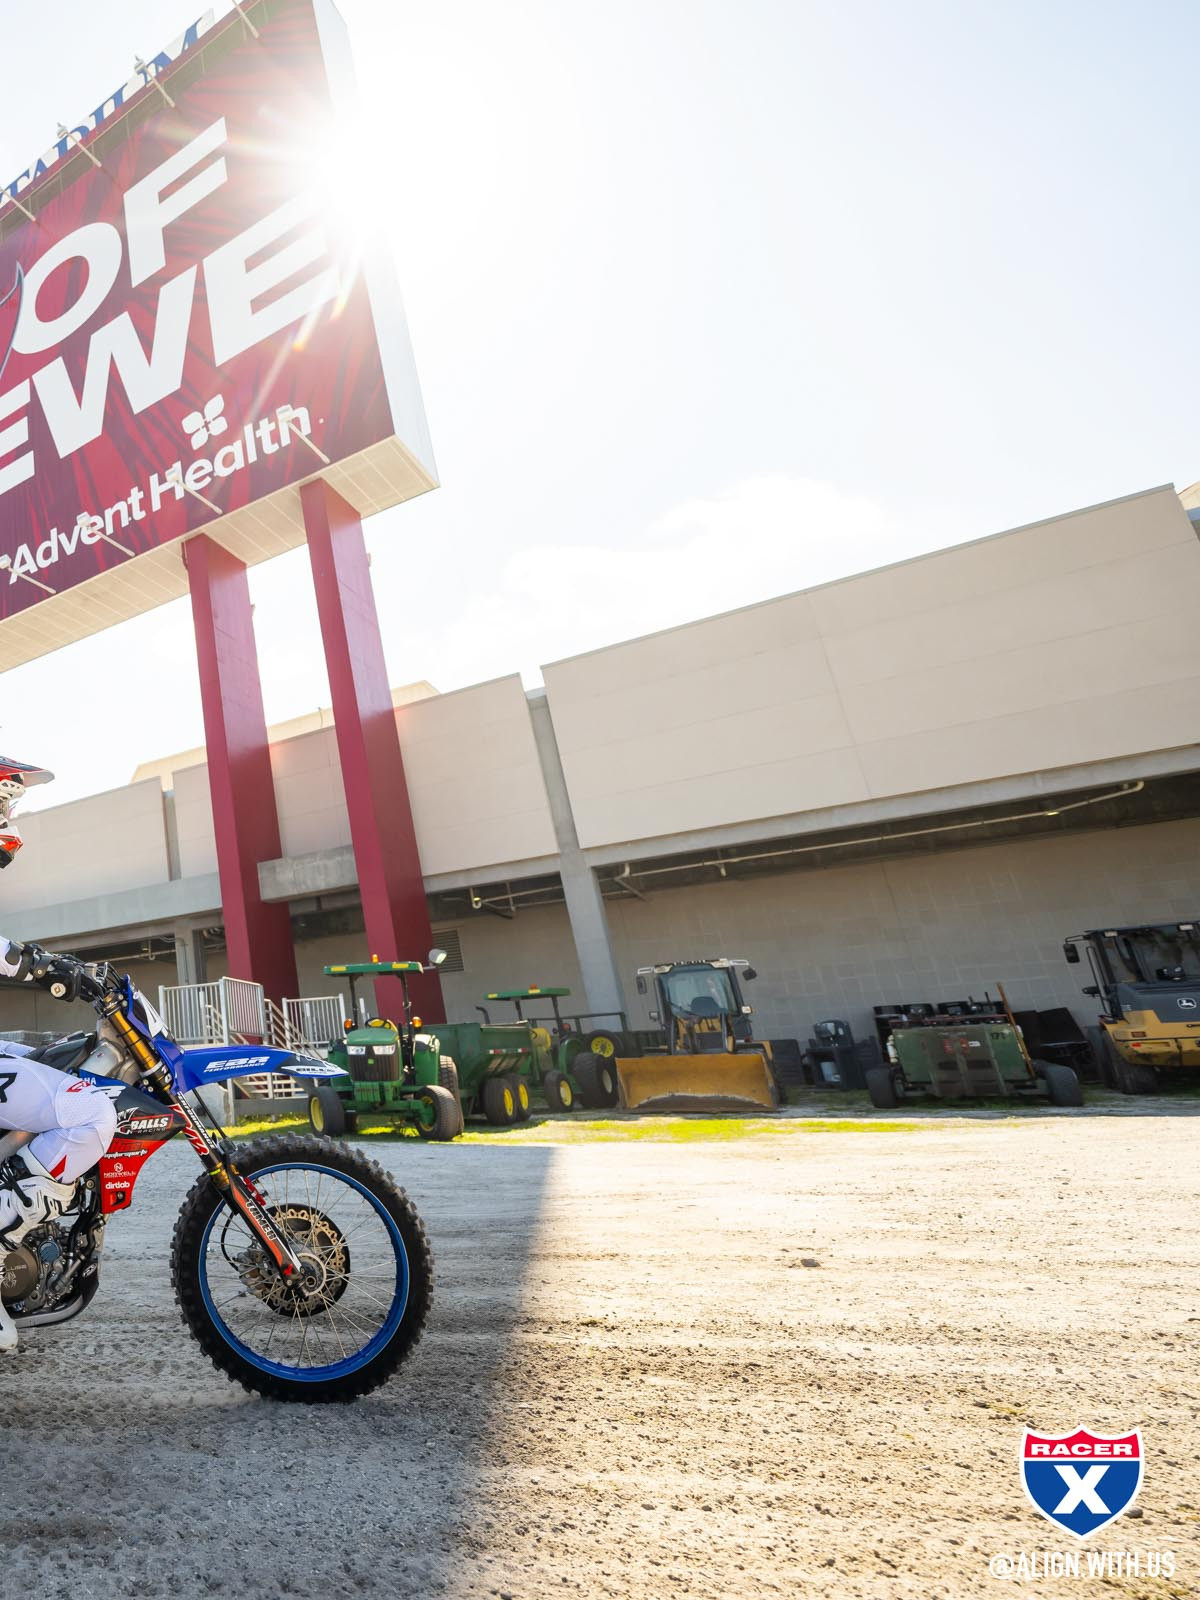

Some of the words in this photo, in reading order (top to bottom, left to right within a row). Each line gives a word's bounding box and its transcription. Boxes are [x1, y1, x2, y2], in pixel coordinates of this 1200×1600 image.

[11, 117, 227, 355] OF
[130, 1117, 169, 1131] BALLS
[105, 1181, 130, 1190] dirtlab
[246, 1199, 277, 1241] TAMER
